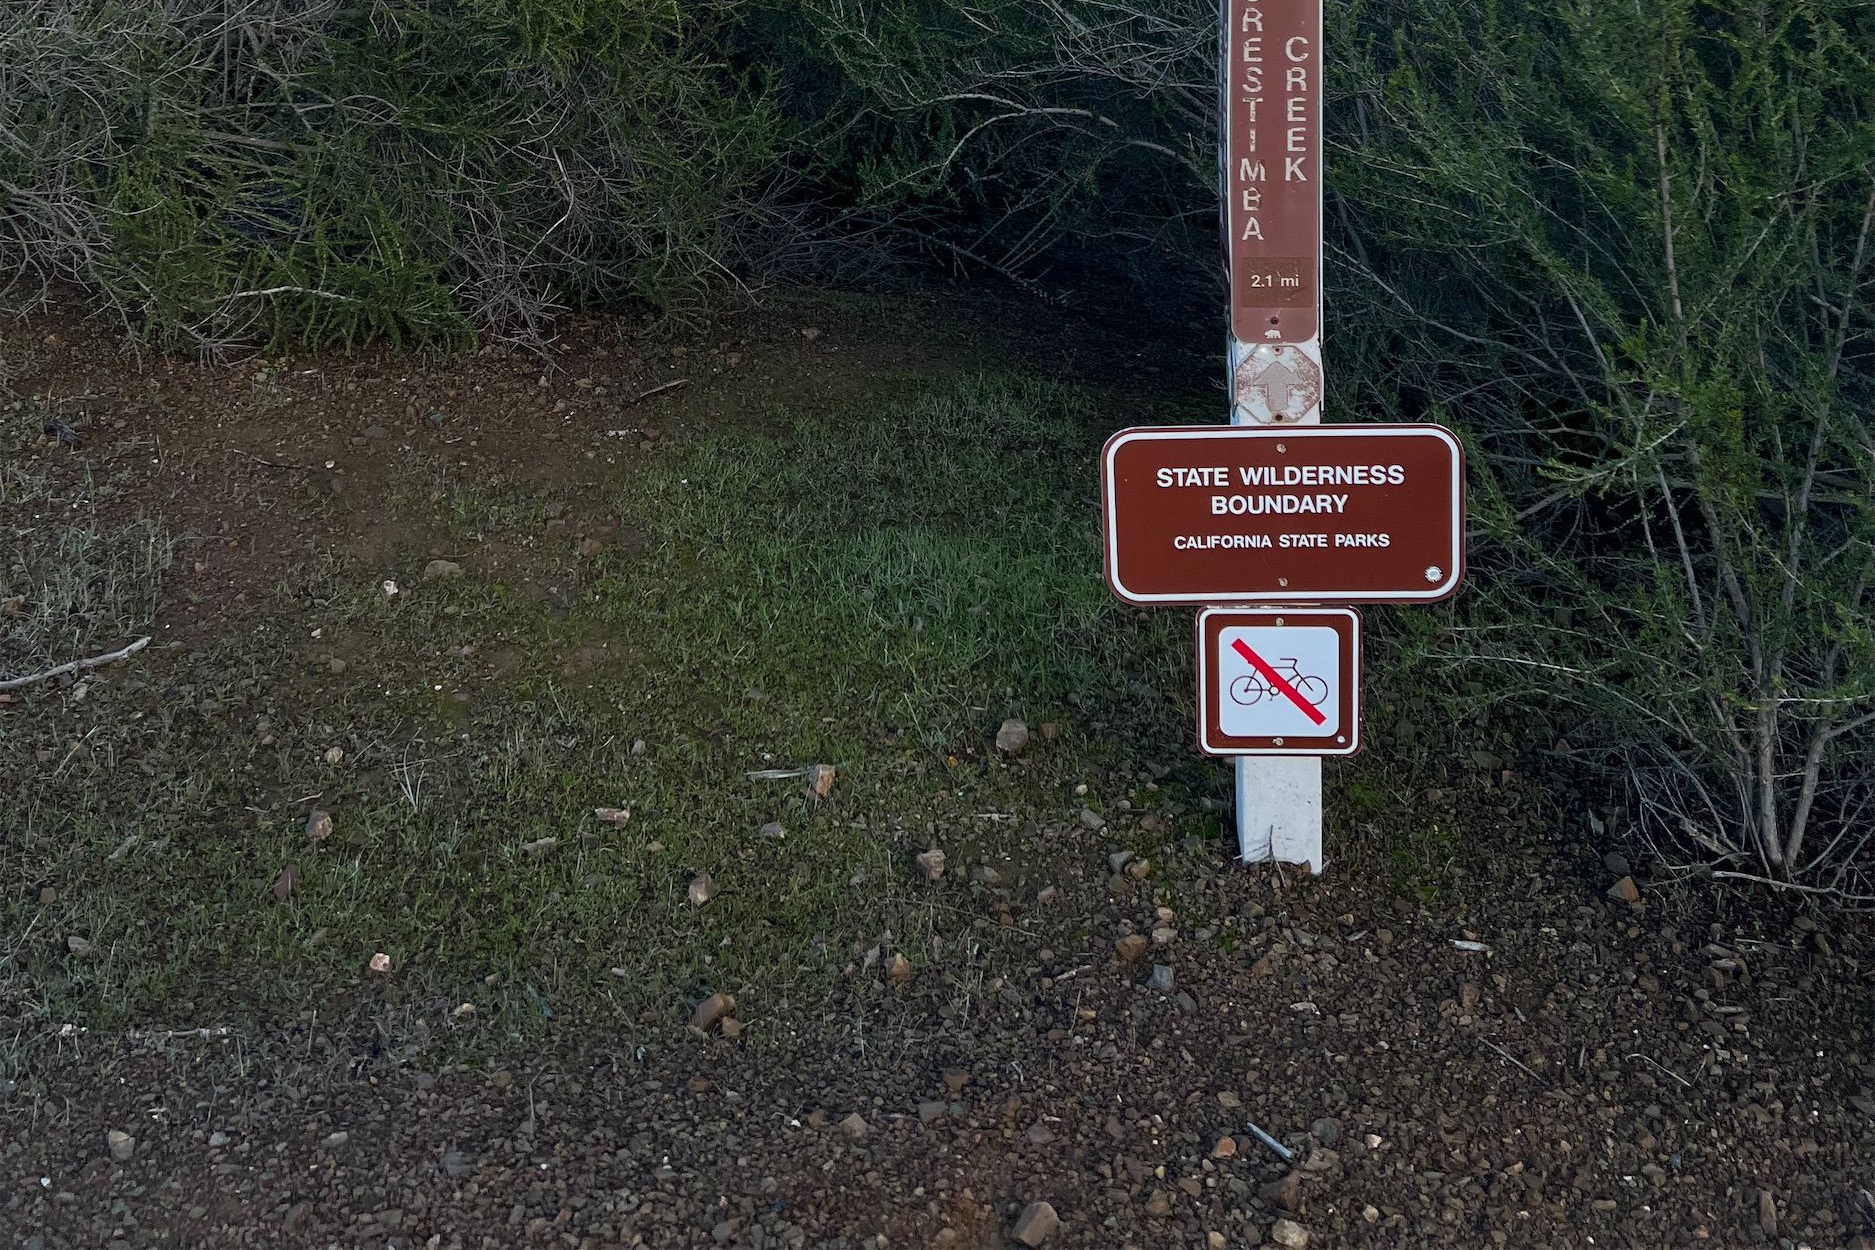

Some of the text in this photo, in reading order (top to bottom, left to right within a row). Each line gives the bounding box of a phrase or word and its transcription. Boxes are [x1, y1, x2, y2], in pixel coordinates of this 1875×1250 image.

[1284, 36, 1308, 183] CREEK
[1251, 274, 1299, 288] 2.1 mi
[1156, 465, 1406, 487] STATE WILDERNESS
[1211, 494, 1349, 515] BOUNDARY
[1174, 533, 1391, 550] CALIFORNIA STATE PARKS
